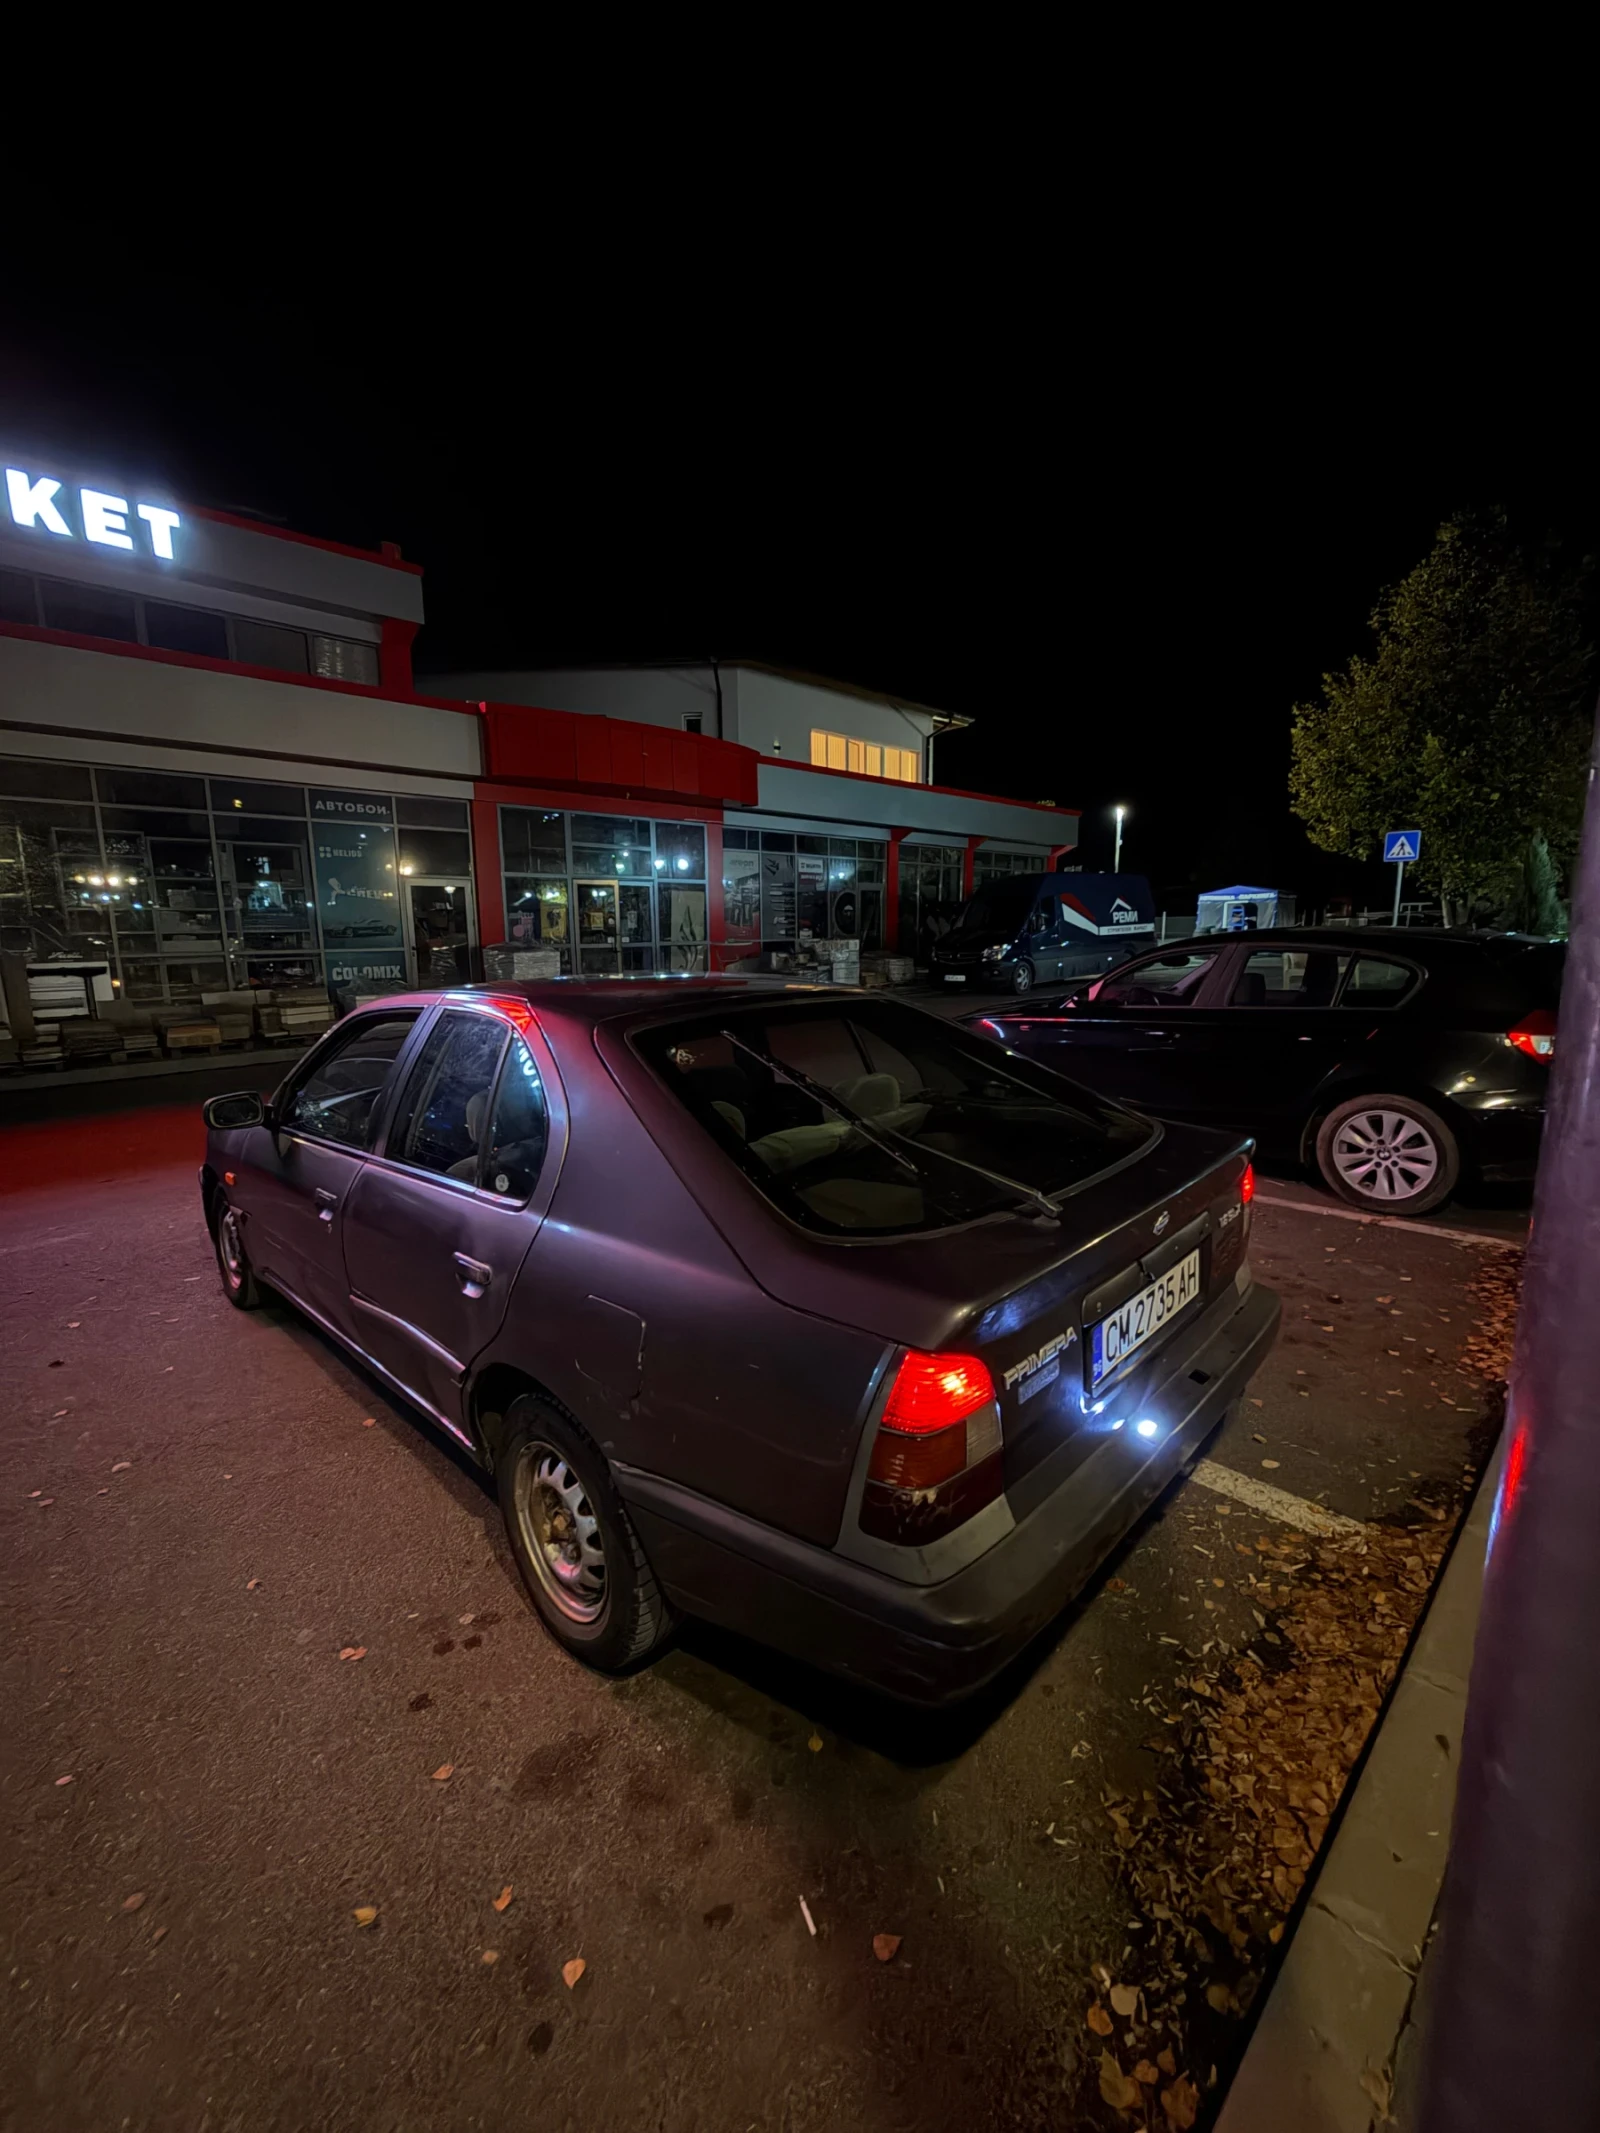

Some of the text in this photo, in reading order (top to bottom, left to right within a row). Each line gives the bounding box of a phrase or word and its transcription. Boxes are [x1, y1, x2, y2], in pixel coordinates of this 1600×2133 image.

[1113, 911, 1138, 924] РЕМИ
[332, 965, 402, 981] COLOMIX
[1105, 1254, 1198, 1363] CM 2735 AH
[1003, 1326, 1078, 1391] PRIMERA
